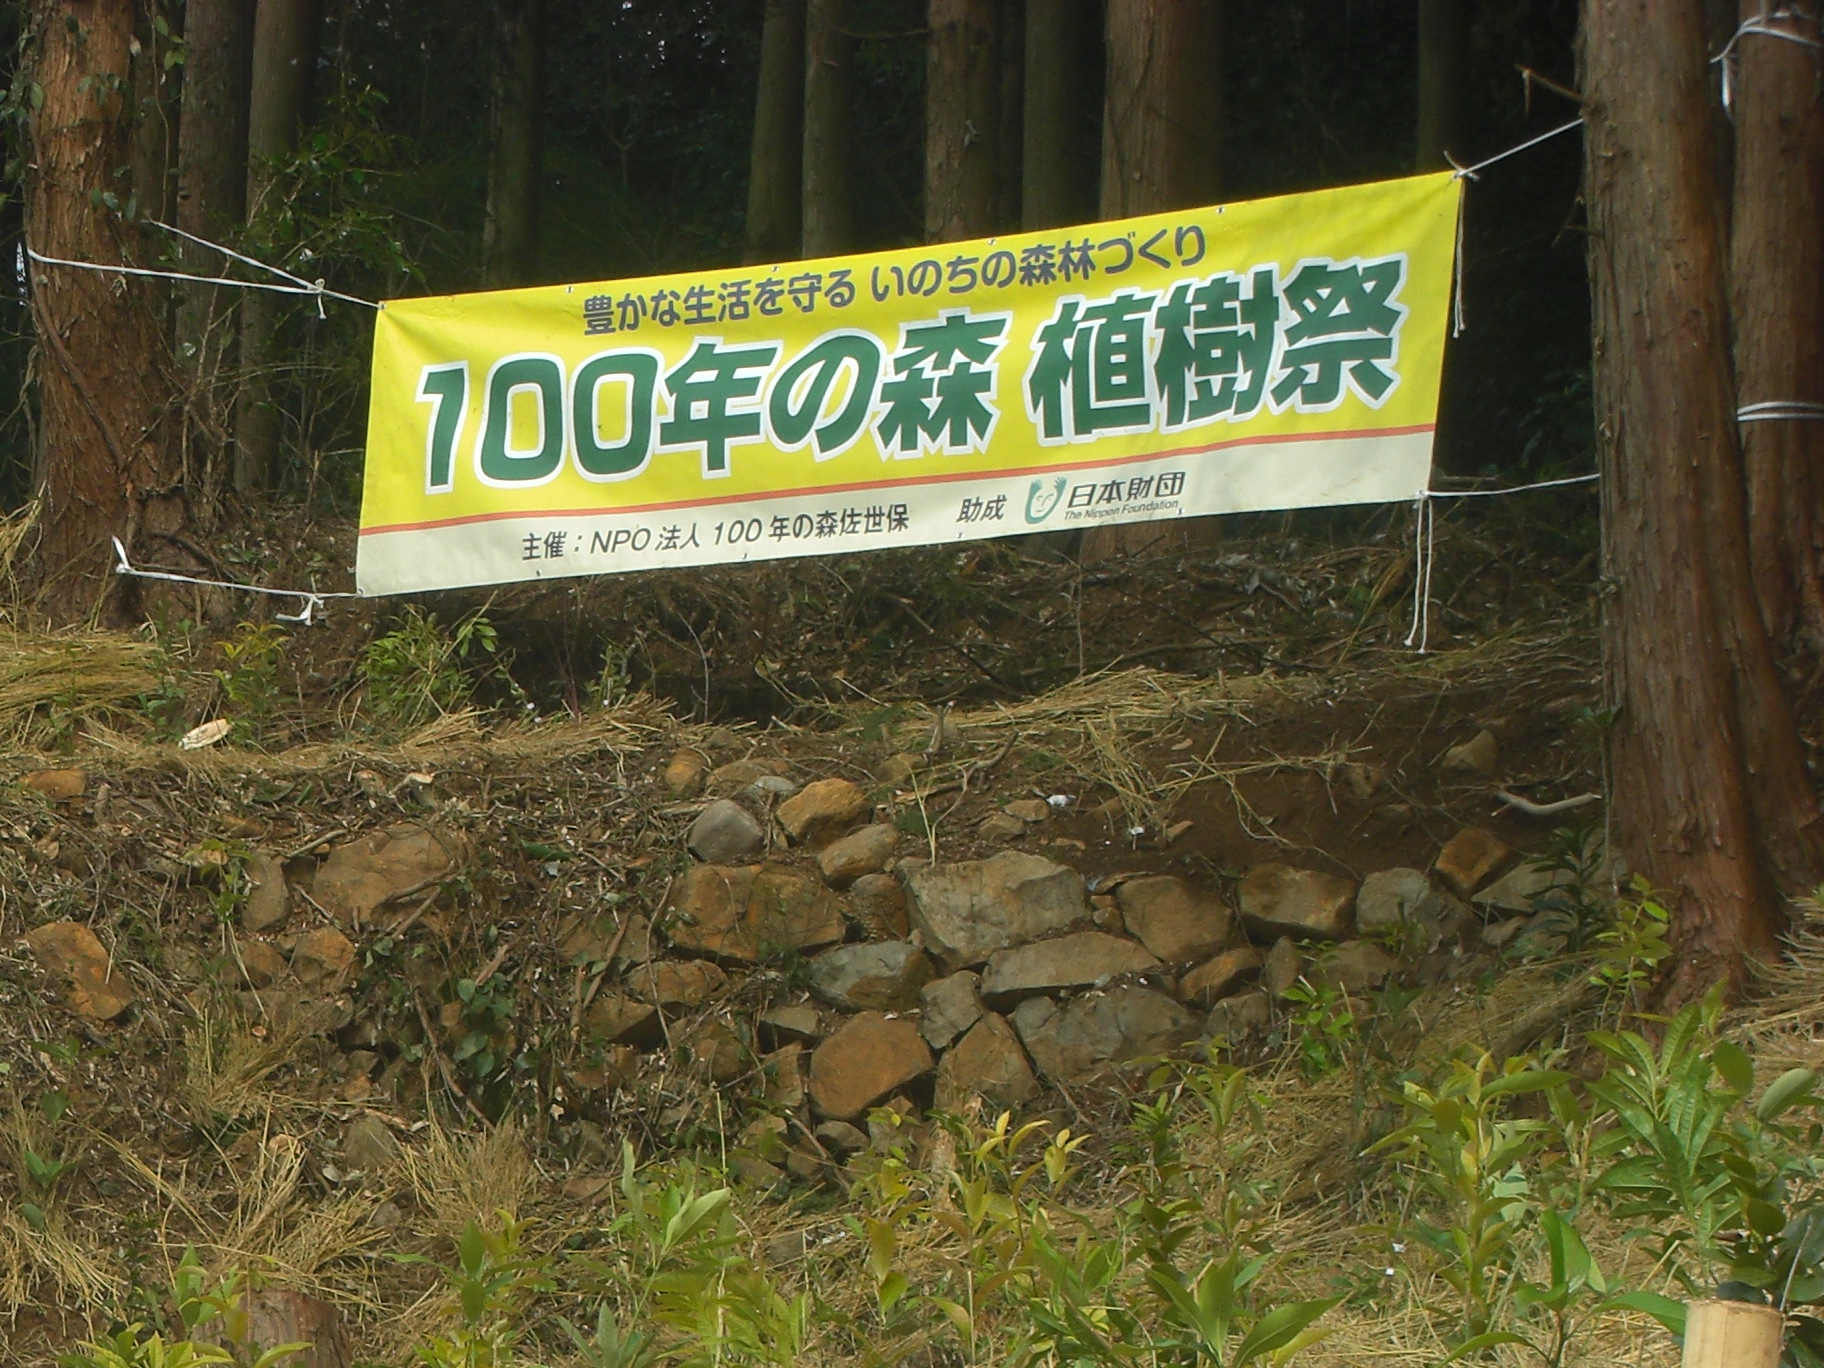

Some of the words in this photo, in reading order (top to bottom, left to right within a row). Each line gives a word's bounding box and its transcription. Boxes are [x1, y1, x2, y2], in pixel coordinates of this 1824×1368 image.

[582, 267, 856, 336] 豊かな生活を守る
[870, 223, 1206, 302] いのちの森林づくり
[417, 309, 1011, 491] 100年の森
[1025, 256, 1405, 443] 植樹祭
[956, 494, 1007, 524] 助成
[1068, 471, 1186, 509] 日本財団
[1064, 510, 1083, 521] The
[1084, 505, 1121, 520] Nippon
[1121, 499, 1179, 515] Foundation
